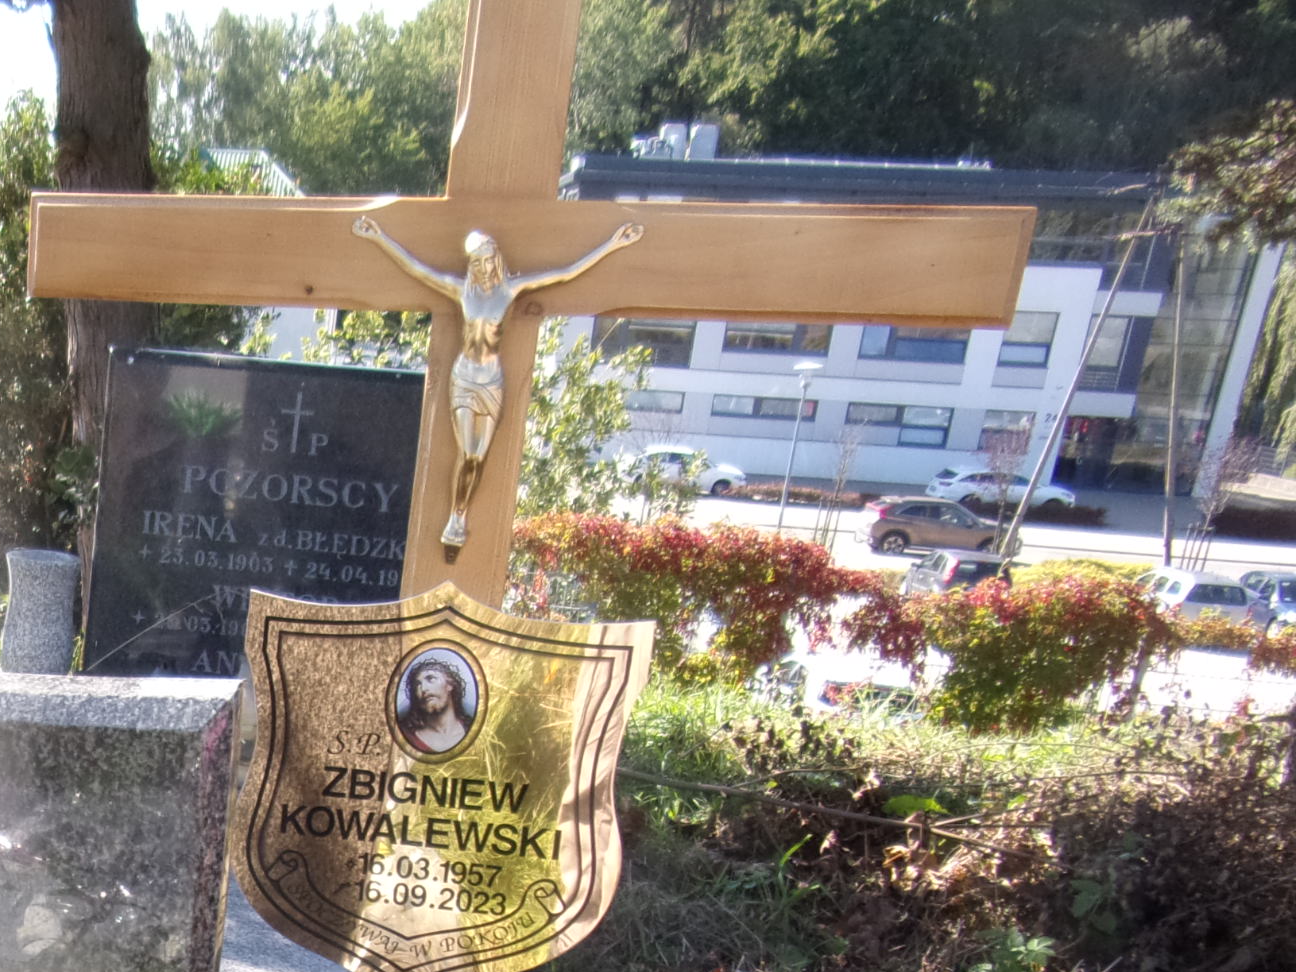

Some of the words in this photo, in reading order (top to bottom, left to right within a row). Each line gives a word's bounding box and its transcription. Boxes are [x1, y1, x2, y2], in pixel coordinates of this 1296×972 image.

[308, 432, 329, 456] P
[182, 464, 399, 513] POZORSCY
[142, 510, 238, 543] IRENA
[304, 561, 399, 588] 24.04.19
[321, 766, 529, 814] ZBIGNIEW
[280, 804, 563, 860] KOWALEWSKI
[359, 852, 503, 888] 16.03.1957
[355, 879, 507, 916] 16.09.2023
